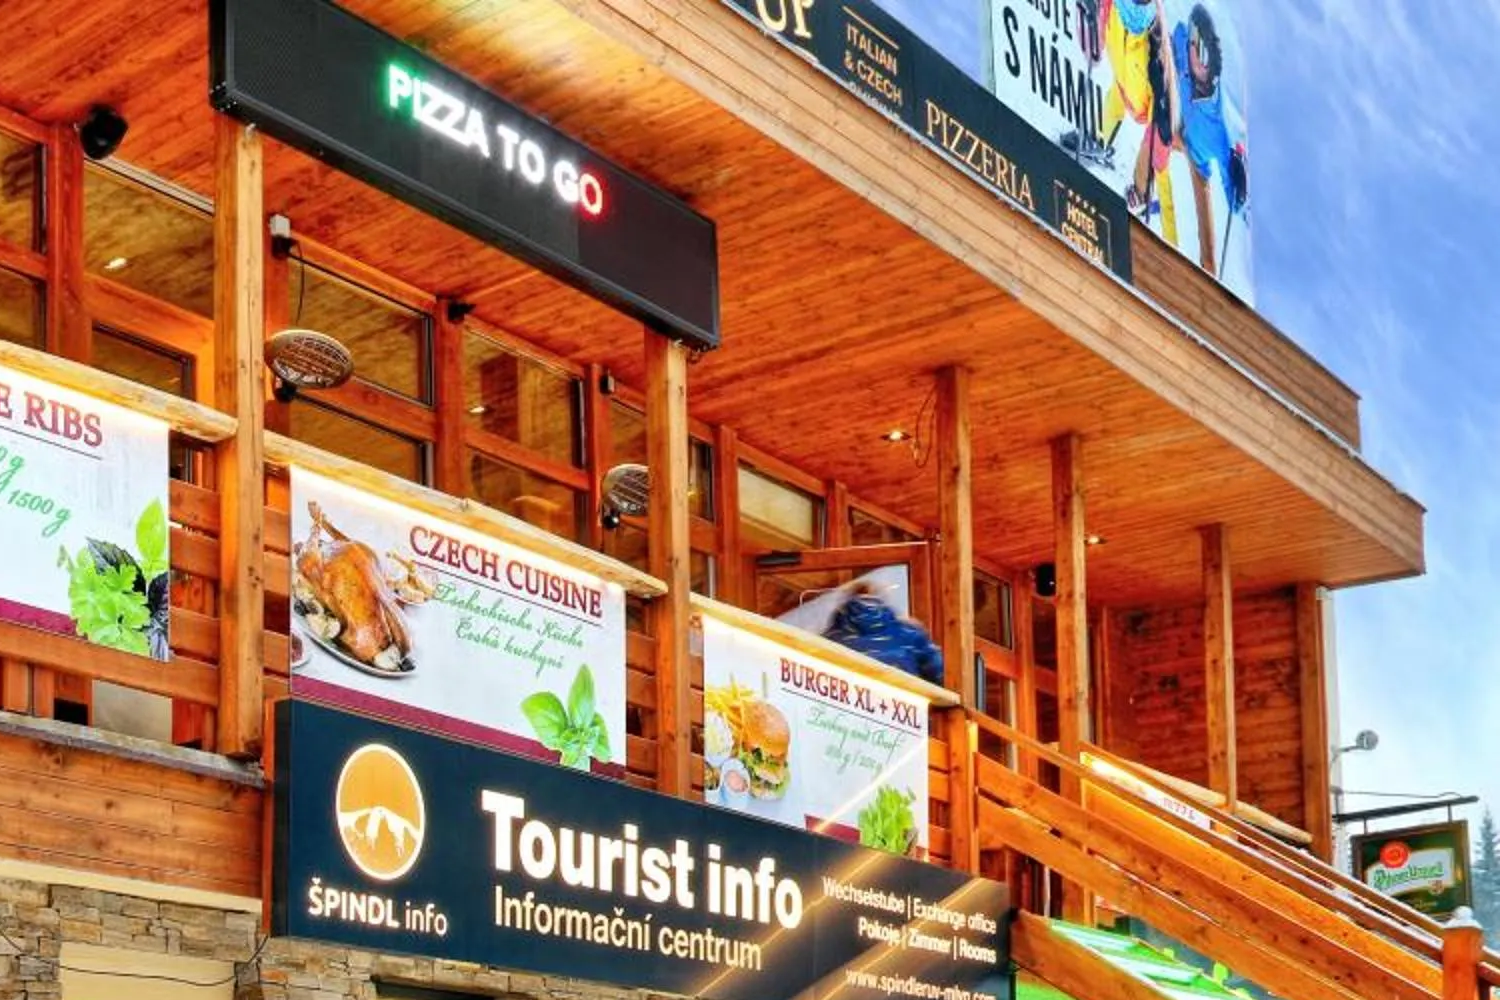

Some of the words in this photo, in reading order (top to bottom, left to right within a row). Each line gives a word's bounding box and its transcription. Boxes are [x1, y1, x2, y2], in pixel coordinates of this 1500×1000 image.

[846, 23, 897, 75] ITALIAN
[1003, 6, 1020, 78] S
[857, 60, 902, 105] CZECH
[389, 63, 490, 158] PIZZA
[497, 124, 546, 185] TO
[553, 160, 603, 216] GO
[925, 99, 1035, 211] PIZZERIA
[1067, 201, 1098, 241] HOTEL
[23, 389, 102, 447] RIBS
[7, 489, 54, 515] 1500
[409, 525, 501, 583] CZECH
[506, 559, 602, 618] CUISINE
[780, 657, 850, 705] BURGER
[854, 684, 875, 714] XL
[891, 699, 922, 729] XXL
[481, 789, 695, 910] Tourist
[708, 844, 803, 929] info
[308, 877, 400, 928] ŠPINDL
[405, 901, 447, 936] info
[495, 885, 652, 951] Informační
[659, 926, 762, 971] centrum
[822, 876, 905, 913] Wechselstube
[914, 897, 966, 930] Exchange
[967, 912, 996, 934] office
[858, 916, 900, 946] Pokoje
[909, 928, 951, 953] Zimmer
[960, 939, 996, 963] Rooms
